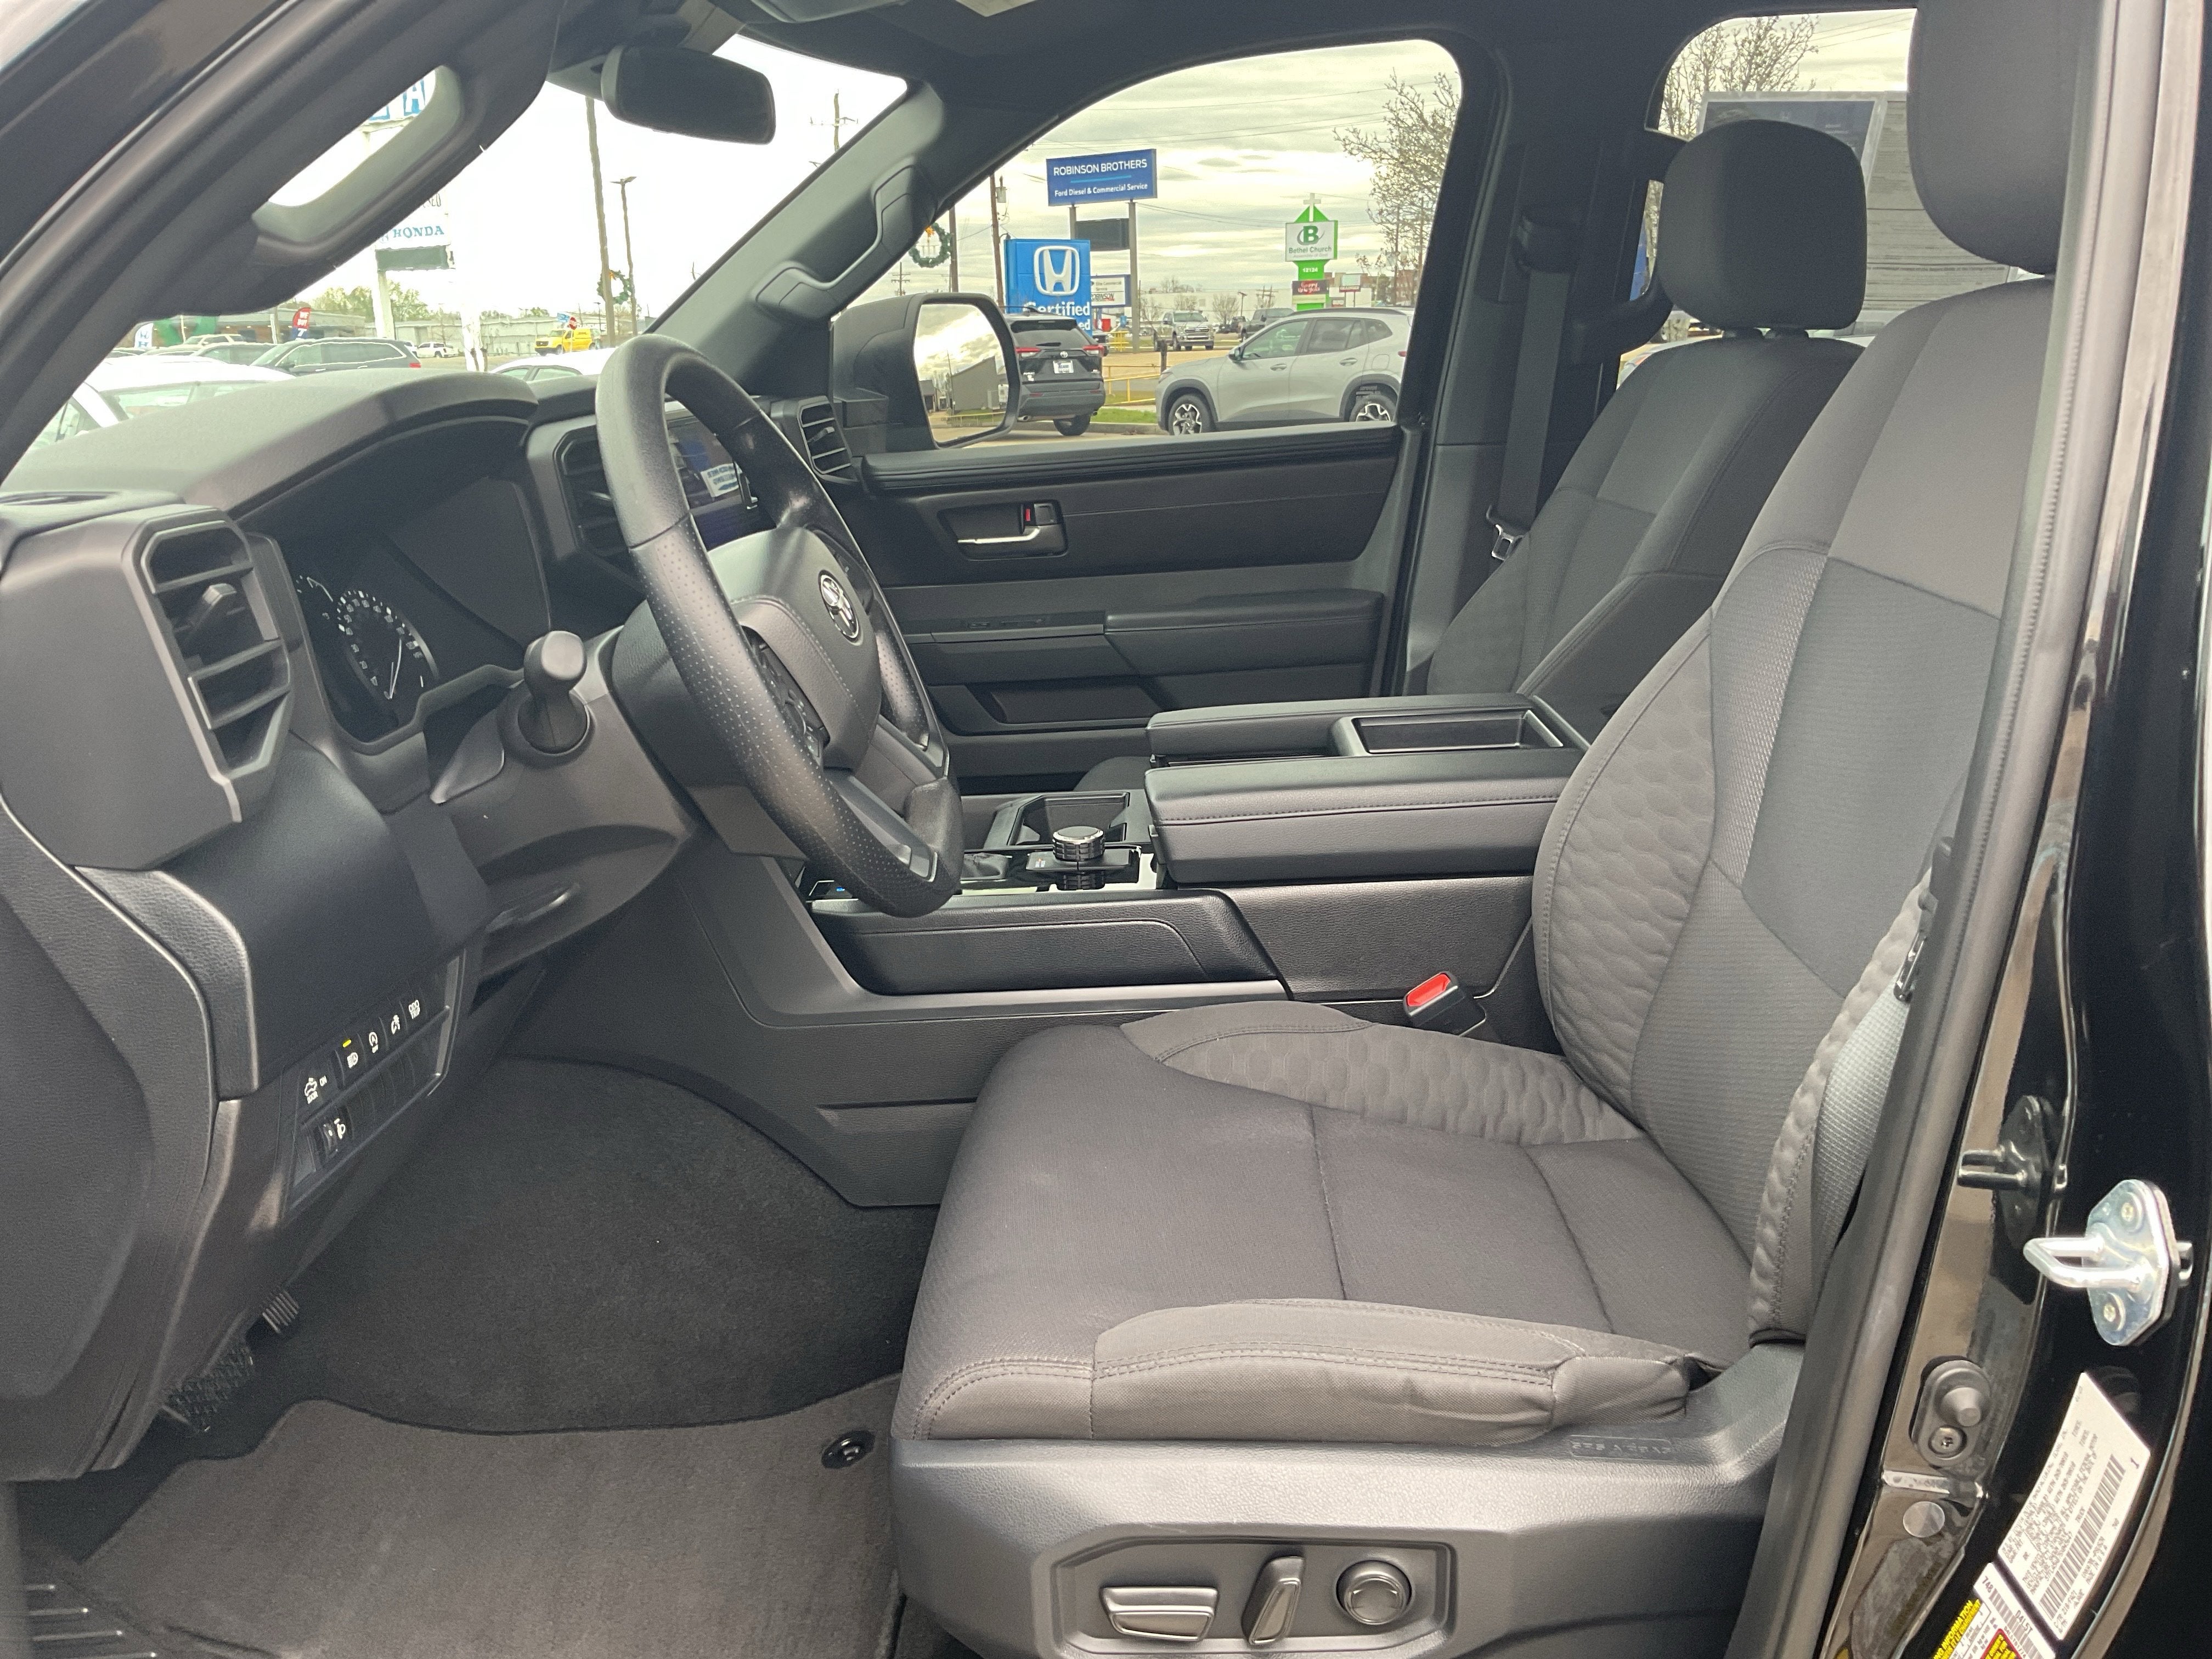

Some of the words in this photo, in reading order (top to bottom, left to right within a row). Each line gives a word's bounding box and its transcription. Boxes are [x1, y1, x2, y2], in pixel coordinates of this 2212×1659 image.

[1053, 163, 1099, 176] ROBINSON
[1101, 159, 1148, 173] BROTHERS
[1093, 184, 1126, 194] Commercial
[1127, 183, 1148, 191] Service
[392, 225, 445, 239] HONDA
[1981, 1575, 1994, 1594] 748
[1940, 1598, 1973, 1651] INFORMATION
